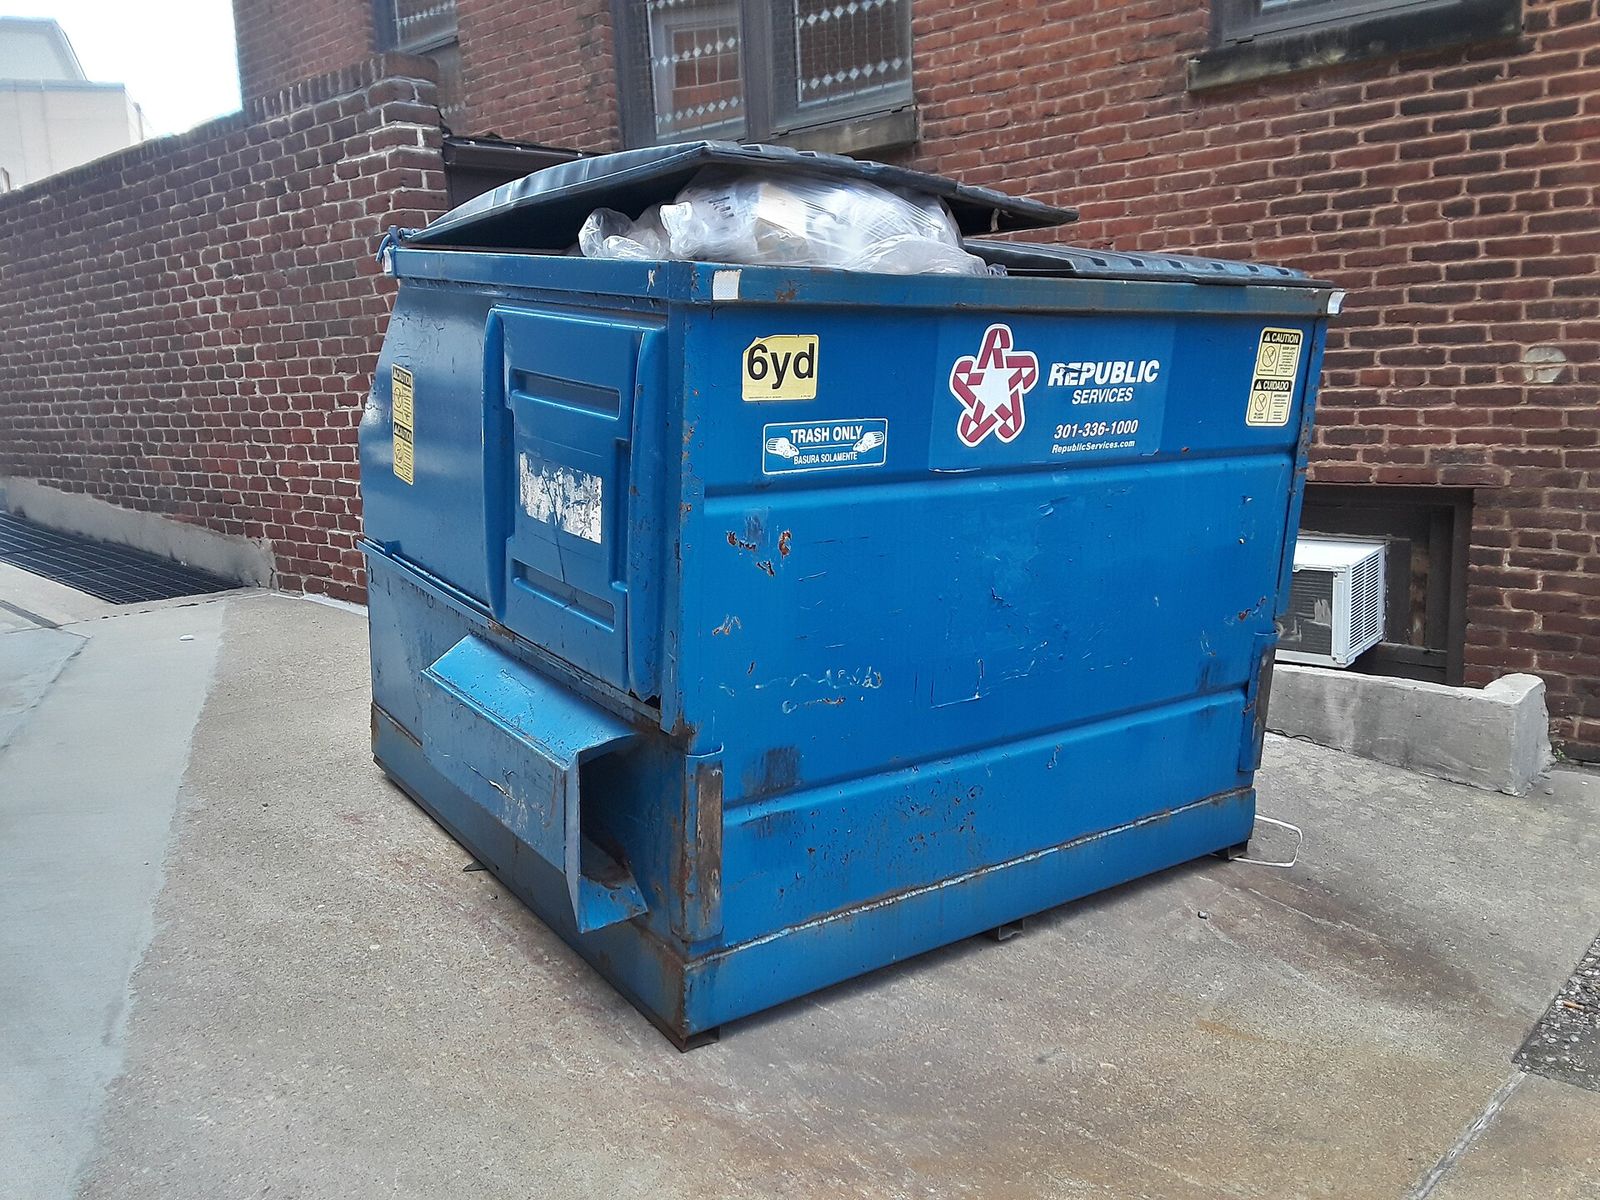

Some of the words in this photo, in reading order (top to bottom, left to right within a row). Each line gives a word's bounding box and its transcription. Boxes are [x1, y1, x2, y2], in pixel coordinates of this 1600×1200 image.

[1271, 332, 1300, 344] CAUTION
[747, 342, 815, 390] 6yd
[1047, 359, 1160, 387] REPUBLIC
[1262, 380, 1290, 391] CUIDADO
[1071, 386, 1134, 405] SERVICES
[790, 426, 830, 444] TRASH
[832, 425, 864, 441] ONLY
[1053, 419, 1139, 439] 301-336-1000
[1051, 440, 1136, 455] RepublicServices.com
[793, 454, 820, 465] BASURA
[820, 451, 858, 463] SOLAMENTE
